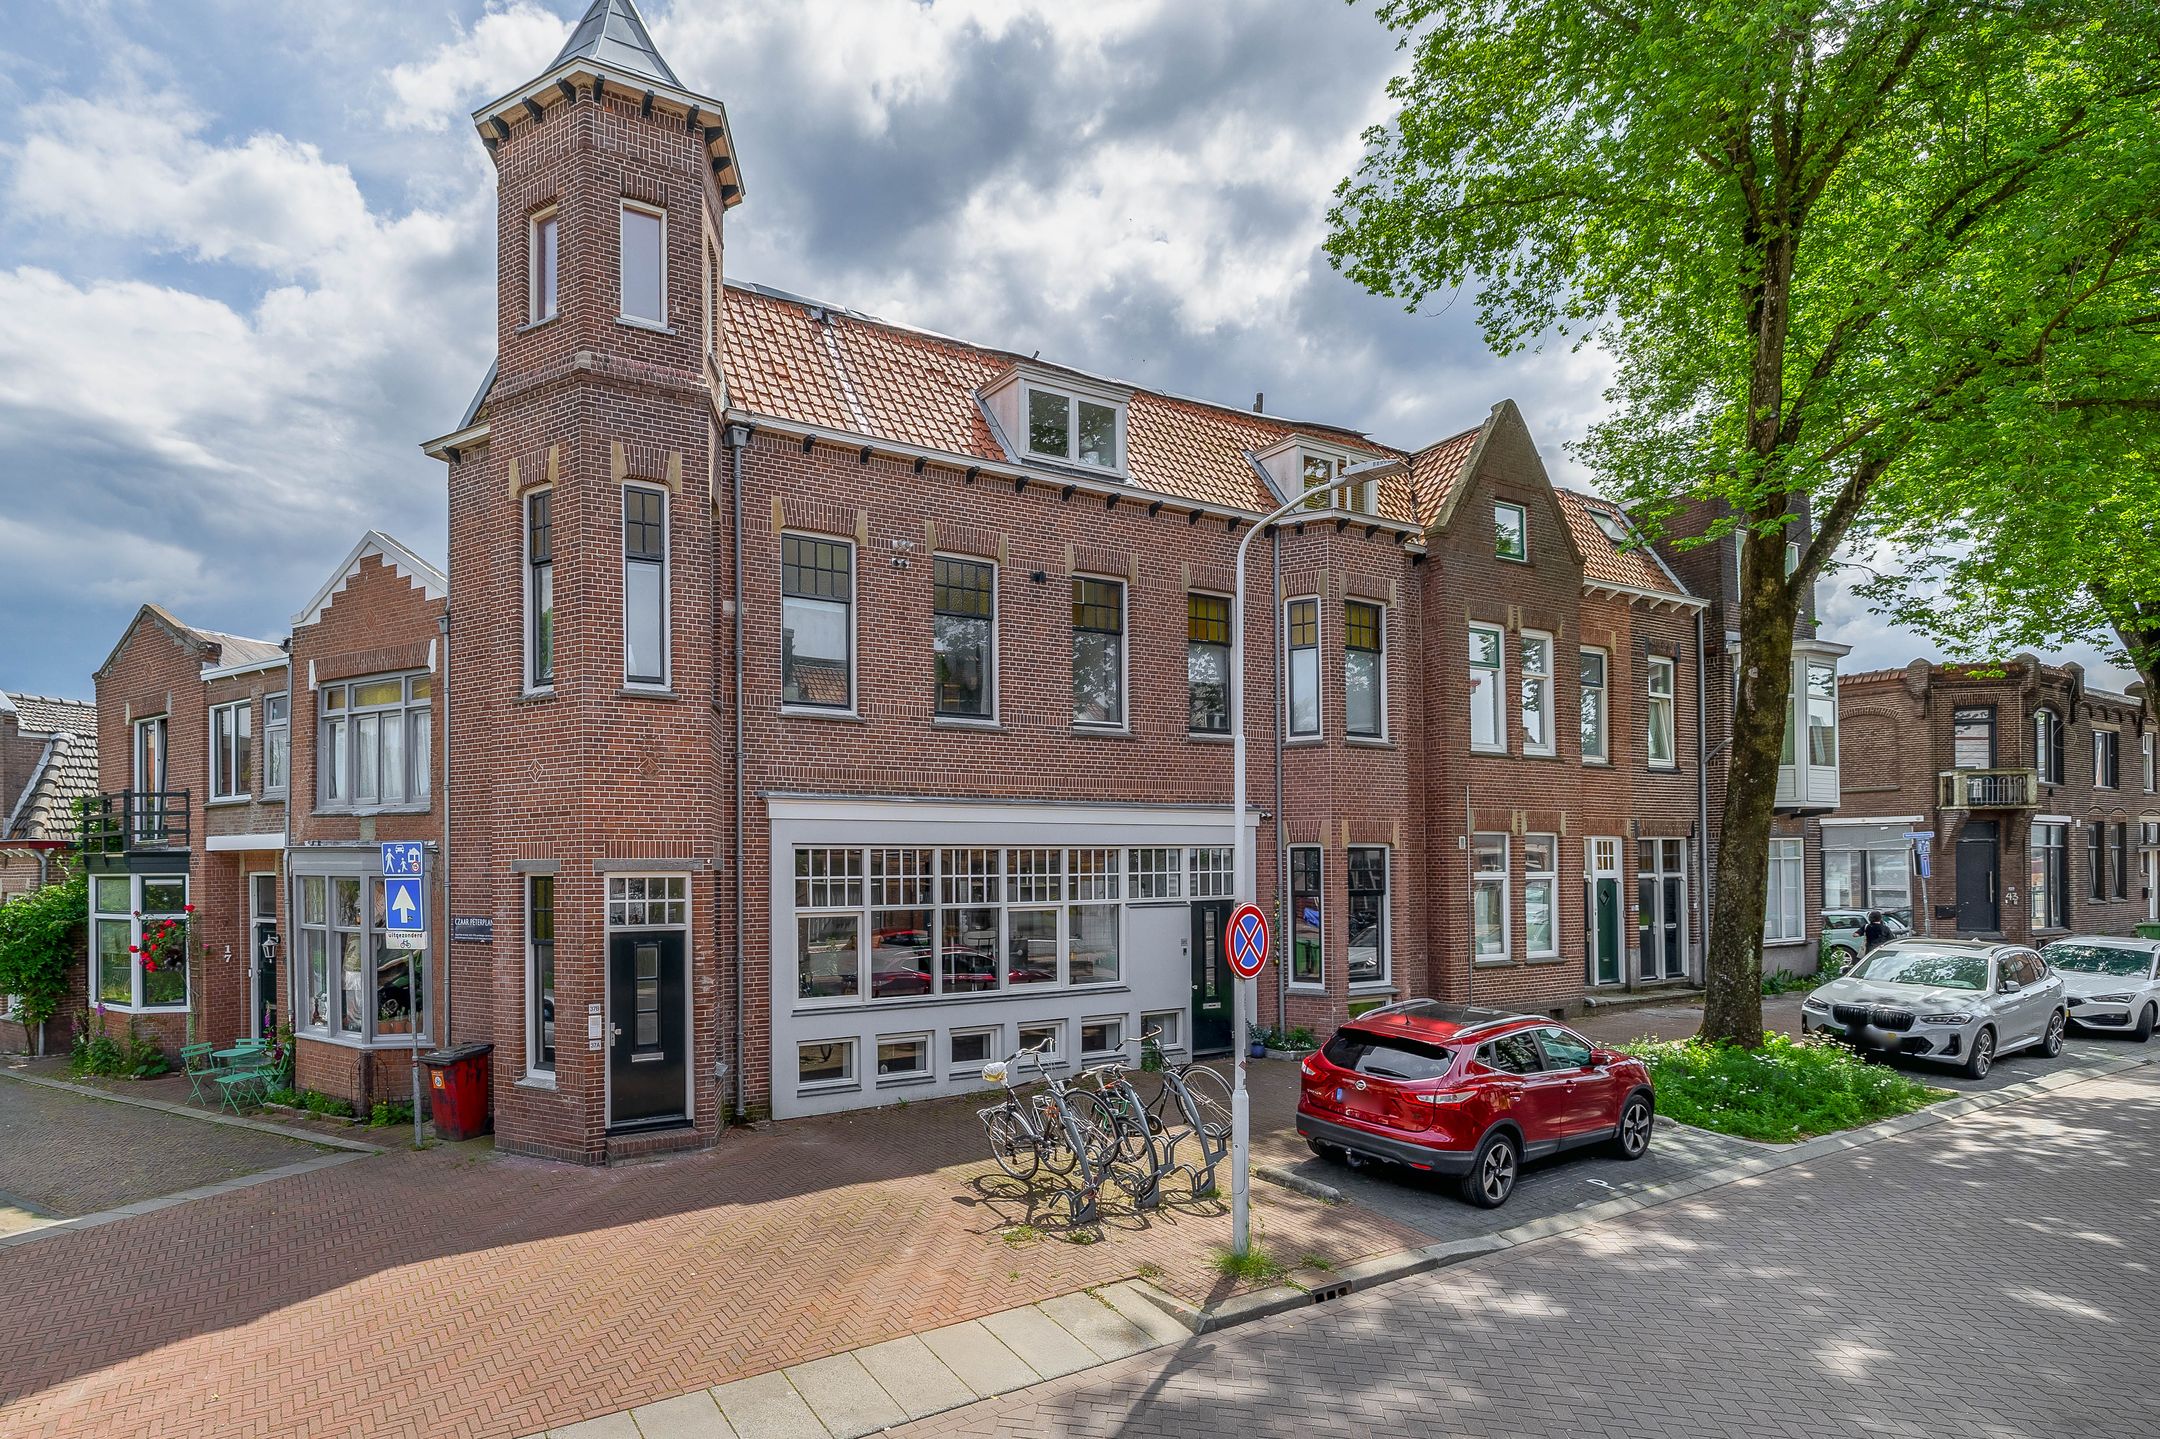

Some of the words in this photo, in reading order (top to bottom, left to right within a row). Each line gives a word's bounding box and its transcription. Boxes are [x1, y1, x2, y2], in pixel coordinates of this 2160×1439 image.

[2005, 892, 2019, 901] 43
[455, 918, 470, 926] CZAAR
[1585, 1178, 1616, 1190] P
